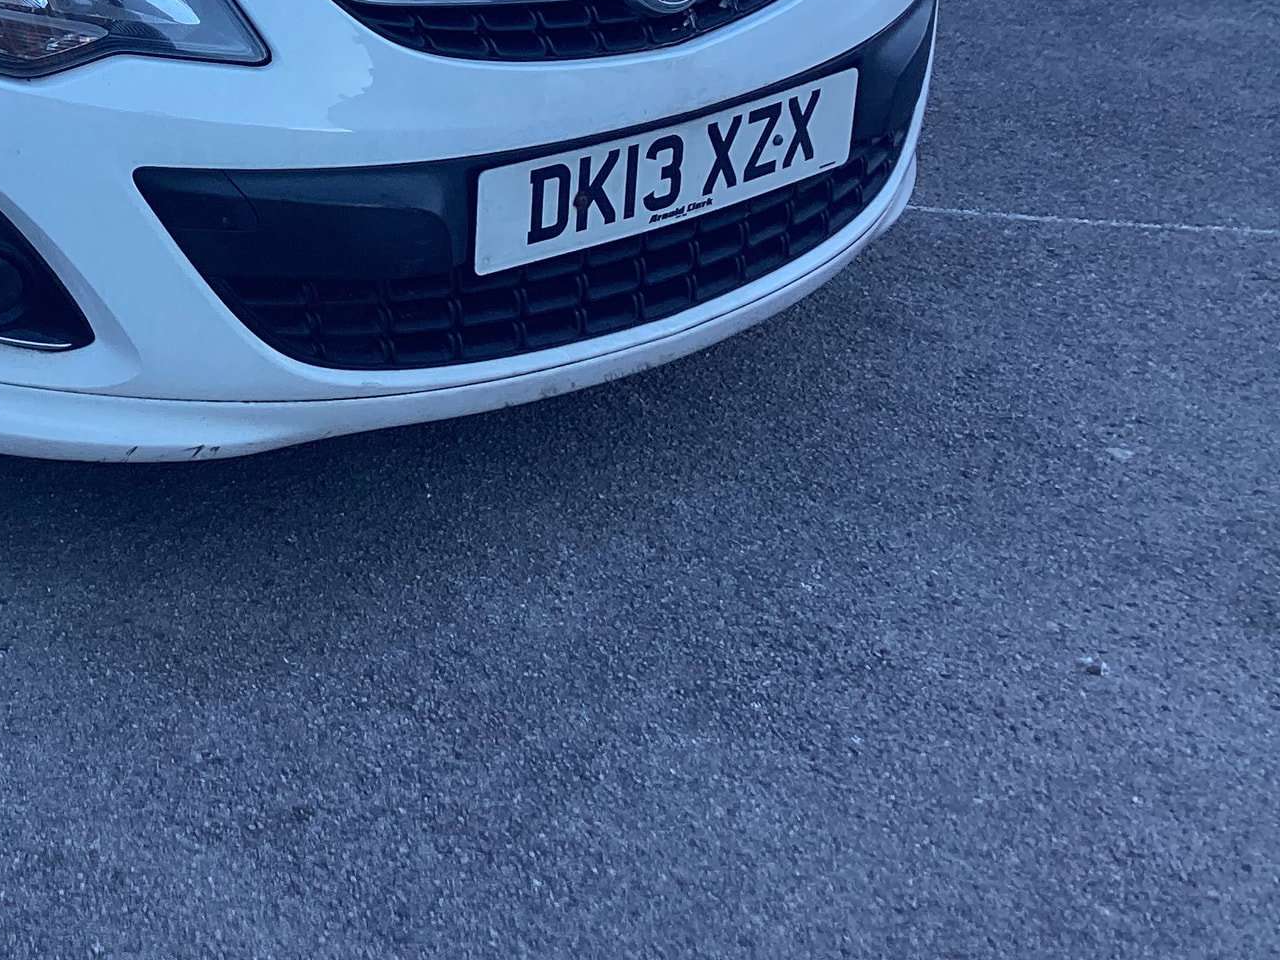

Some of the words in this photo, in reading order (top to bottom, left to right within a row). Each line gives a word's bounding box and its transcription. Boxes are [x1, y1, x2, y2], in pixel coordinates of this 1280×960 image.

[527, 134, 684, 245] DK13
[702, 88, 820, 196] XZX
[649, 206, 685, 224] Arnold
[687, 197, 713, 213] Clark
